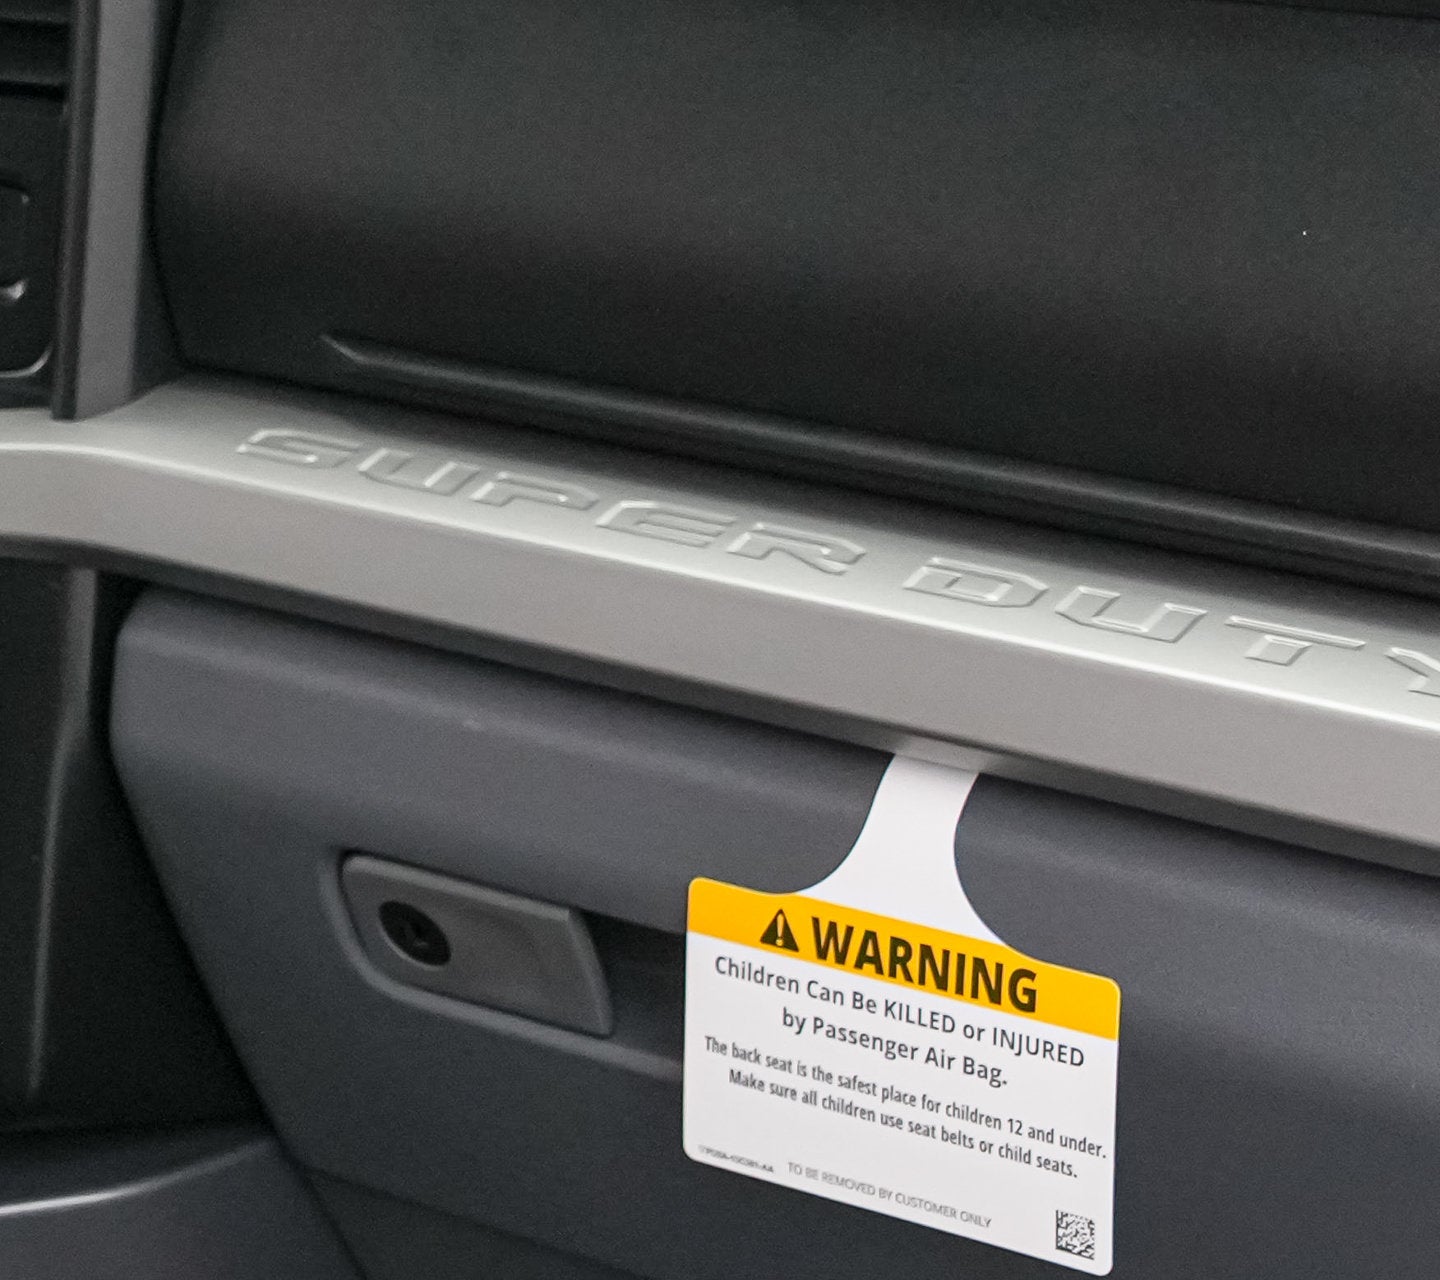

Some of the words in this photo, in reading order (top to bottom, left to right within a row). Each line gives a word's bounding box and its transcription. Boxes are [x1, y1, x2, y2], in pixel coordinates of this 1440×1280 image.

[235, 428, 867, 576] SUPER
[714, 956, 799, 994] Children
[807, 980, 844, 1005] Can
[852, 991, 877, 1014] Be
[884, 999, 955, 1033] KILLED
[963, 1024, 985, 1041] or
[993, 1027, 1084, 1067] INJURED
[811, 915, 1037, 1013] WARNING
[705, 1035, 727, 1056] The
[732, 1041, 761, 1065] back
[765, 1054, 792, 1073] seat
[796, 1059, 807, 1077] is
[812, 1065, 833, 1085] the
[837, 1074, 877, 1097] safest
[881, 1084, 917, 1107] place
[921, 1093, 941, 1114] for
[945, 1101, 1002, 1130] children
[1007, 1117, 1023, 1136] 12
[1028, 1126, 1054, 1144] and
[1059, 1134, 1107, 1159] under.
[783, 1007, 806, 1035] by
[813, 1017, 918, 1060] Passenger
[924, 1046, 955, 1070] Air
[963, 1056, 1008, 1088] Bag.
[729, 1068, 765, 1092] Make
[769, 1081, 797, 1101] sure
[801, 1089, 818, 1107] all
[821, 1094, 876, 1123] children
[880, 1112, 903, 1130] use
[908, 1120, 936, 1139] seat
[941, 1125, 974, 1149] belts
[979, 1140, 994, 1154] or
[998, 1142, 1031, 1165] child
[1035, 1154, 1078, 1179] seats.
[788, 1161, 802, 1176] TO
[805, 1166, 819, 1180] BE
[821, 1172, 875, 1196] REMOVED
[878, 1187, 893, 1201] BY
[895, 1192, 957, 1219] CUSTOMER
[960, 1210, 992, 1228] ONLY
